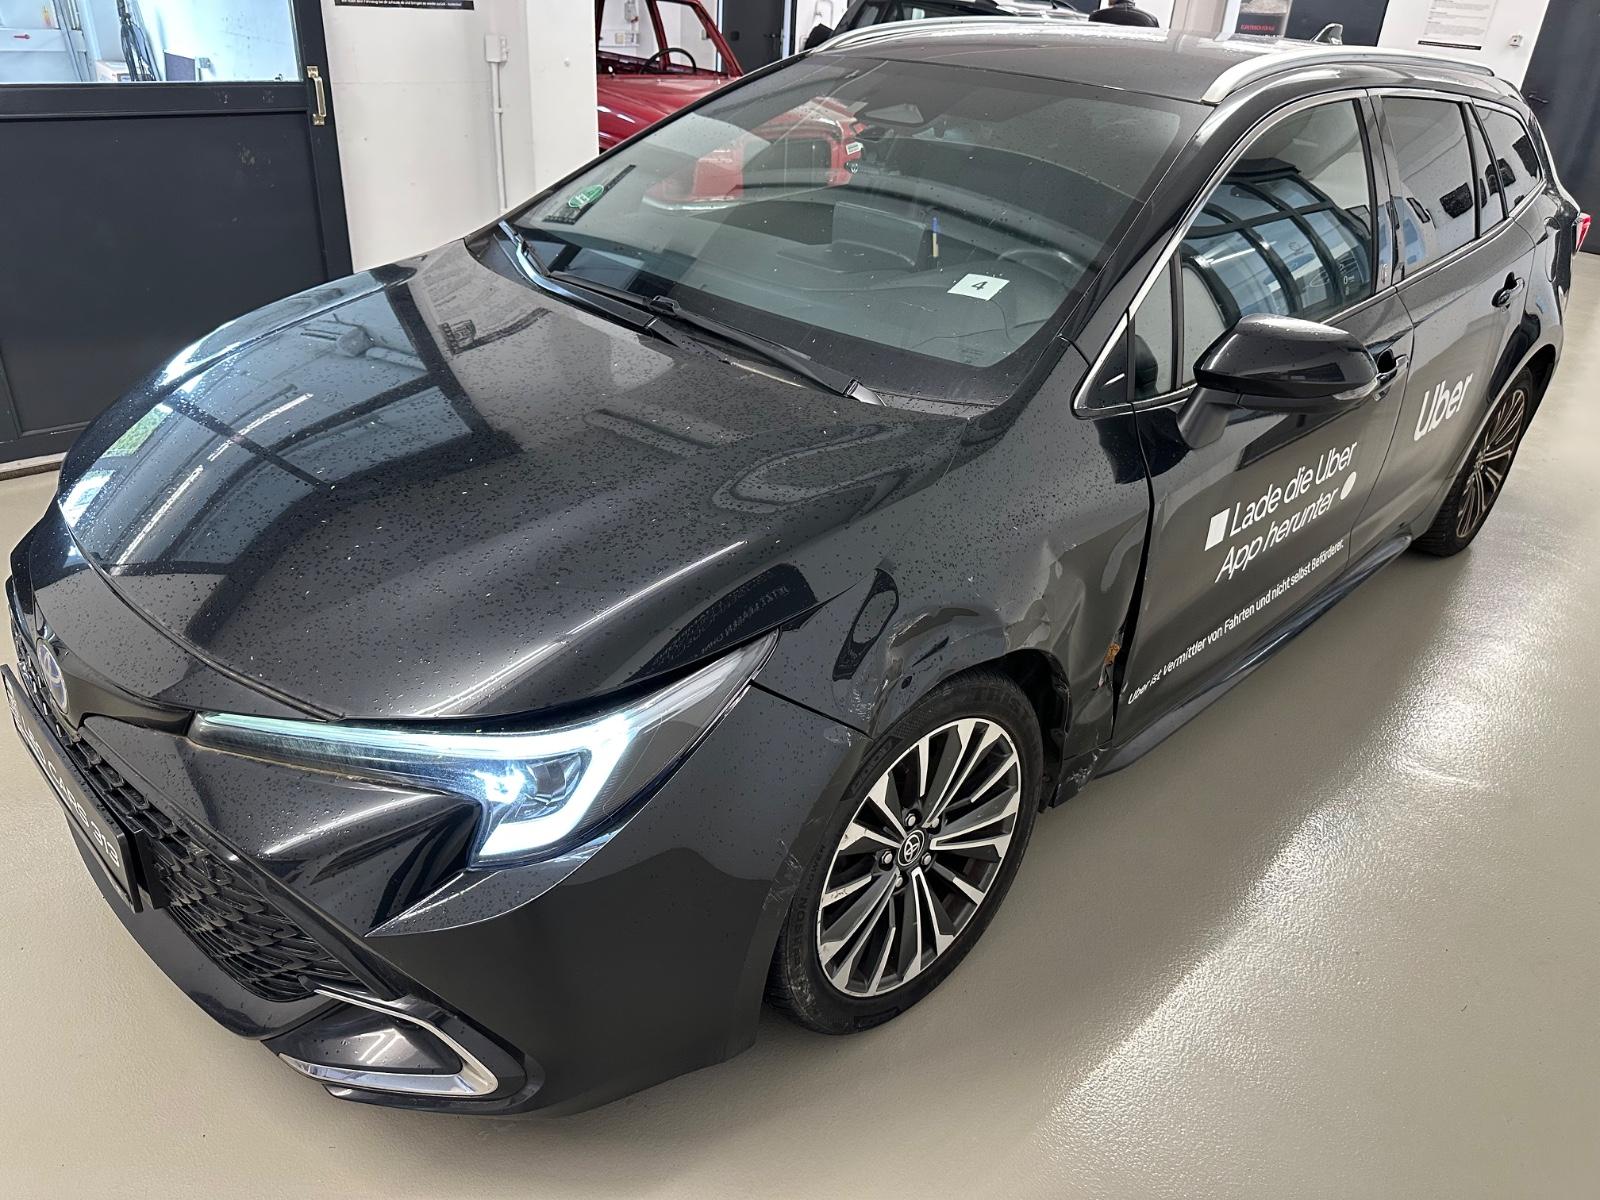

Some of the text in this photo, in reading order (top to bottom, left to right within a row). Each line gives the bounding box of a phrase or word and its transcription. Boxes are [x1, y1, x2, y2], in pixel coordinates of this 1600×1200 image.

[971, 281, 988, 291] 4
[1414, 373, 1473, 441] Uber
[1215, 488, 1339, 583] App herunter
[1229, 442, 1357, 537] Lade die Uber
[1128, 539, 1344, 704] Uber ist Vermittler von Fahrten und nicht selbst Beförderer.
[48, 761, 120, 867] CARS 313
